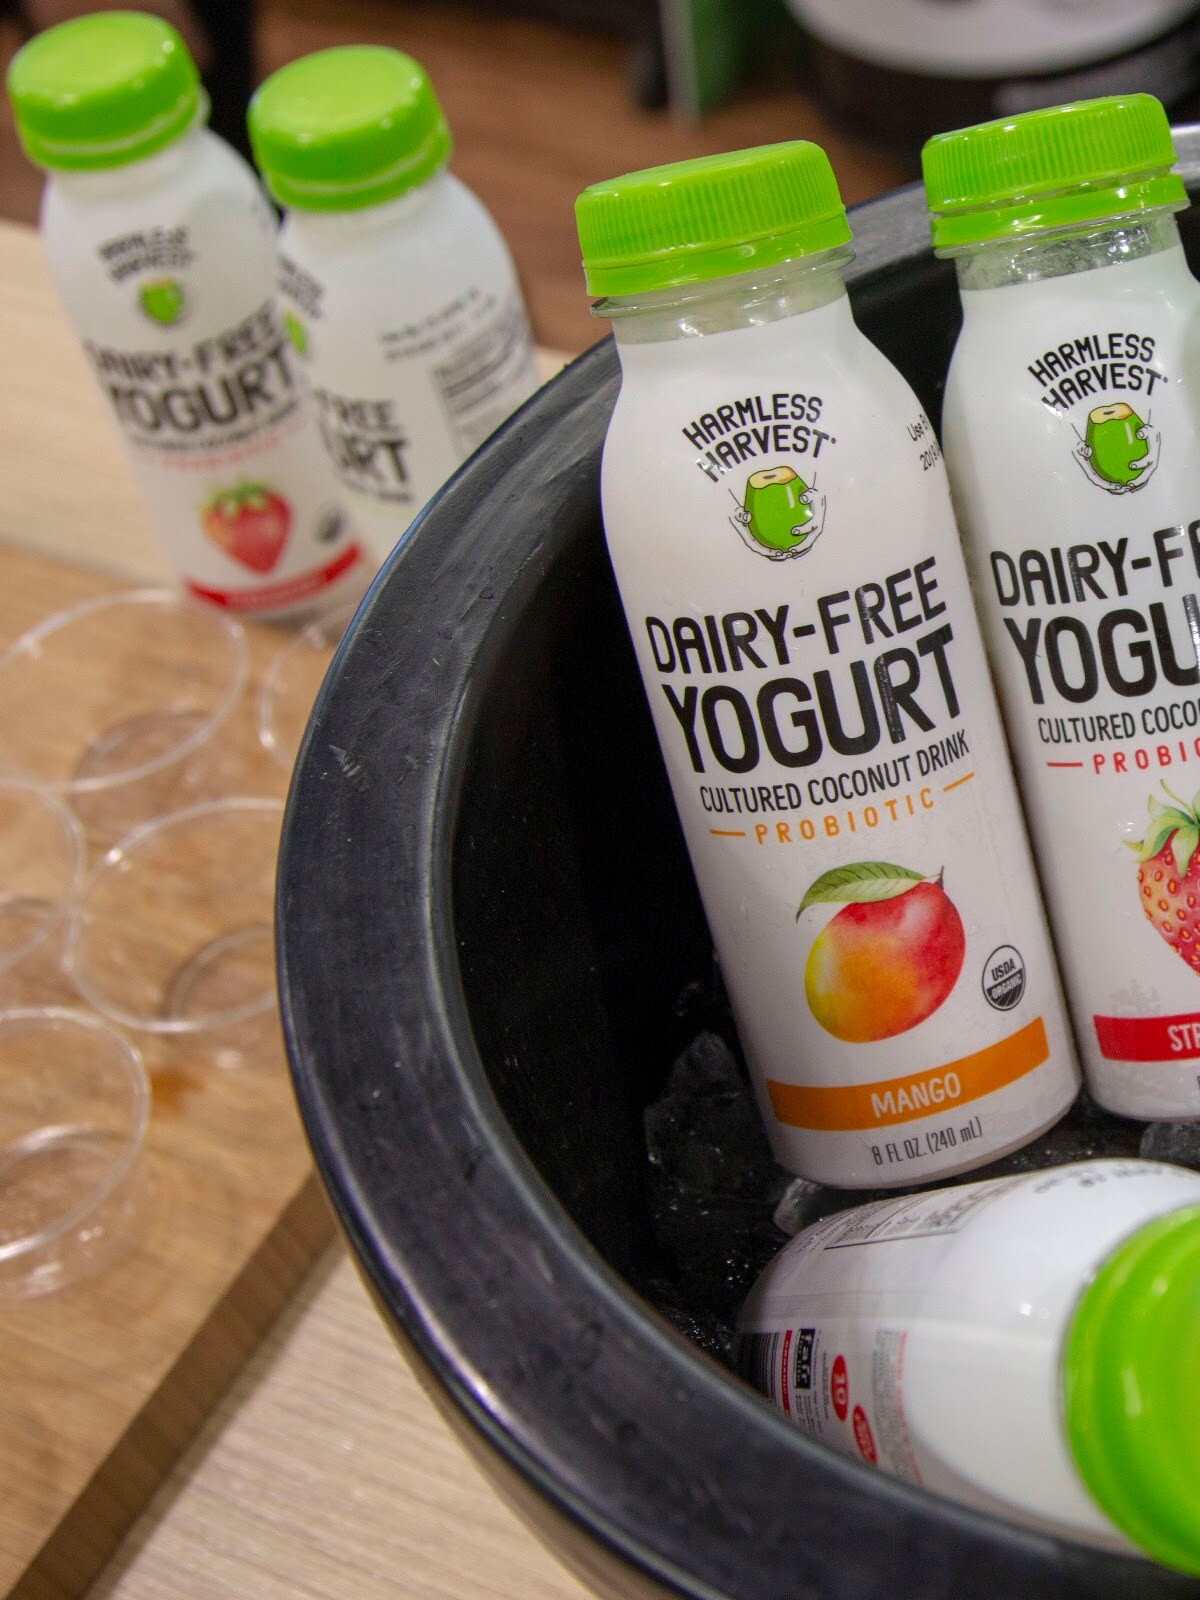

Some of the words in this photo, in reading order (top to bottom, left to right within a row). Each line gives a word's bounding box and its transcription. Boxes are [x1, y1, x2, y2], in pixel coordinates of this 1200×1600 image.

[1028, 333, 1155, 387] HARMLESS
[1042, 363, 1162, 412] HARVEST
[682, 393, 823, 450] HARMLESS
[696, 424, 829, 483] HARVEST
[645, 556, 947, 674] DAIRY-FREE
[661, 622, 961, 774] YOGURT
[1037, 711, 1136, 744] CULTURED
[699, 782, 803, 814] CULTURED
[807, 755, 912, 807] COCONUT
[918, 729, 971, 777] DRINK
[754, 787, 935, 845] PROBIOTIC
[990, 974, 1022, 999] ORGANIC
[991, 957, 1017, 981] USDA
[871, 1072, 961, 1118] MANGO
[873, 1146, 883, 1166] 8
[886, 1141, 901, 1162] FL
[903, 1136, 927, 1162] OZ.
[927, 1125, 957, 1153] (240
[960, 1116, 984, 1140] mL)
